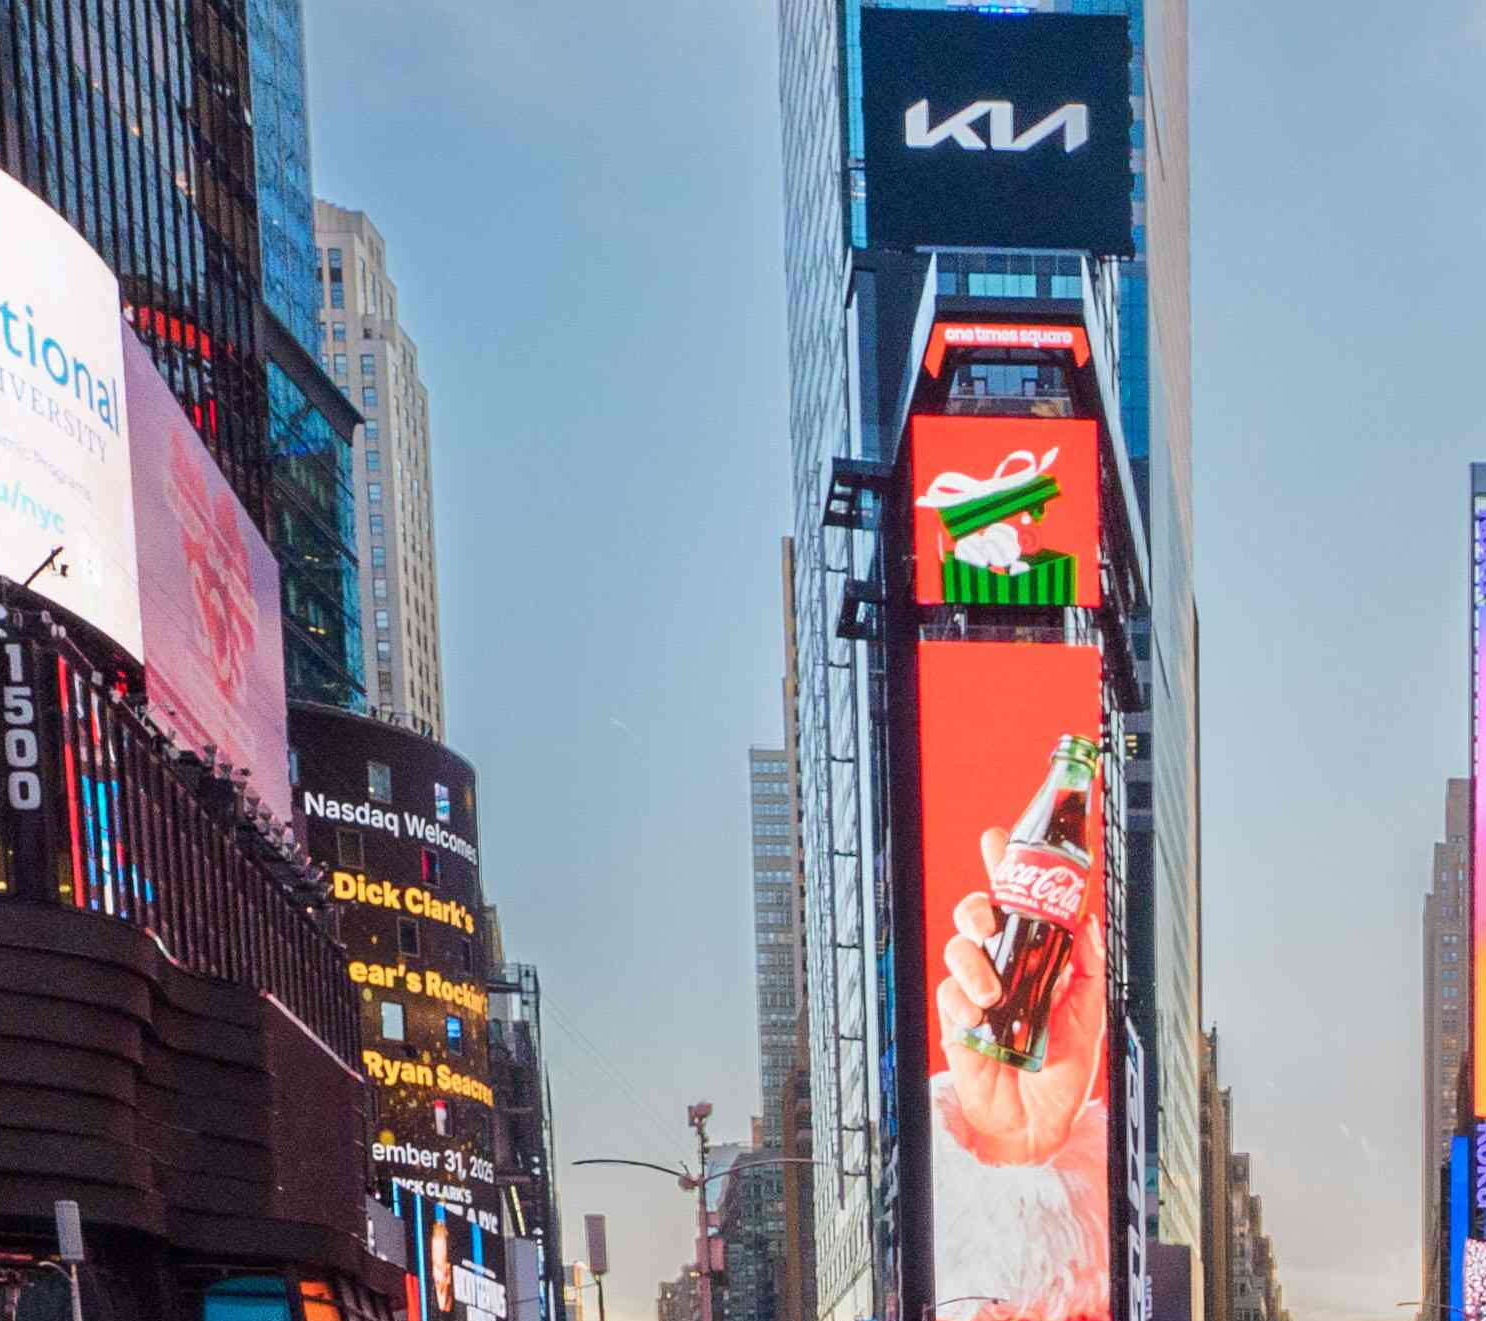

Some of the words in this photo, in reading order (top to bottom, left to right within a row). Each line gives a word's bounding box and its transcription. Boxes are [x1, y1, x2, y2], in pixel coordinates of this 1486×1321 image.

[944, 327, 974, 344] one
[975, 327, 1017, 344] times
[1019, 327, 1074, 347] square
[3, 644, 41, 812] 1500
[304, 793, 399, 835] Nasdaq
[404, 816, 477, 865] Welcomes
[333, 871, 401, 909] Dick
[404, 887, 474, 934] Clark's
[363, 1050, 433, 1087] Ryan
[372, 1142, 440, 1171] ember
[444, 1150, 466, 1181] 31,
[470, 1156, 494, 1184] 2025
